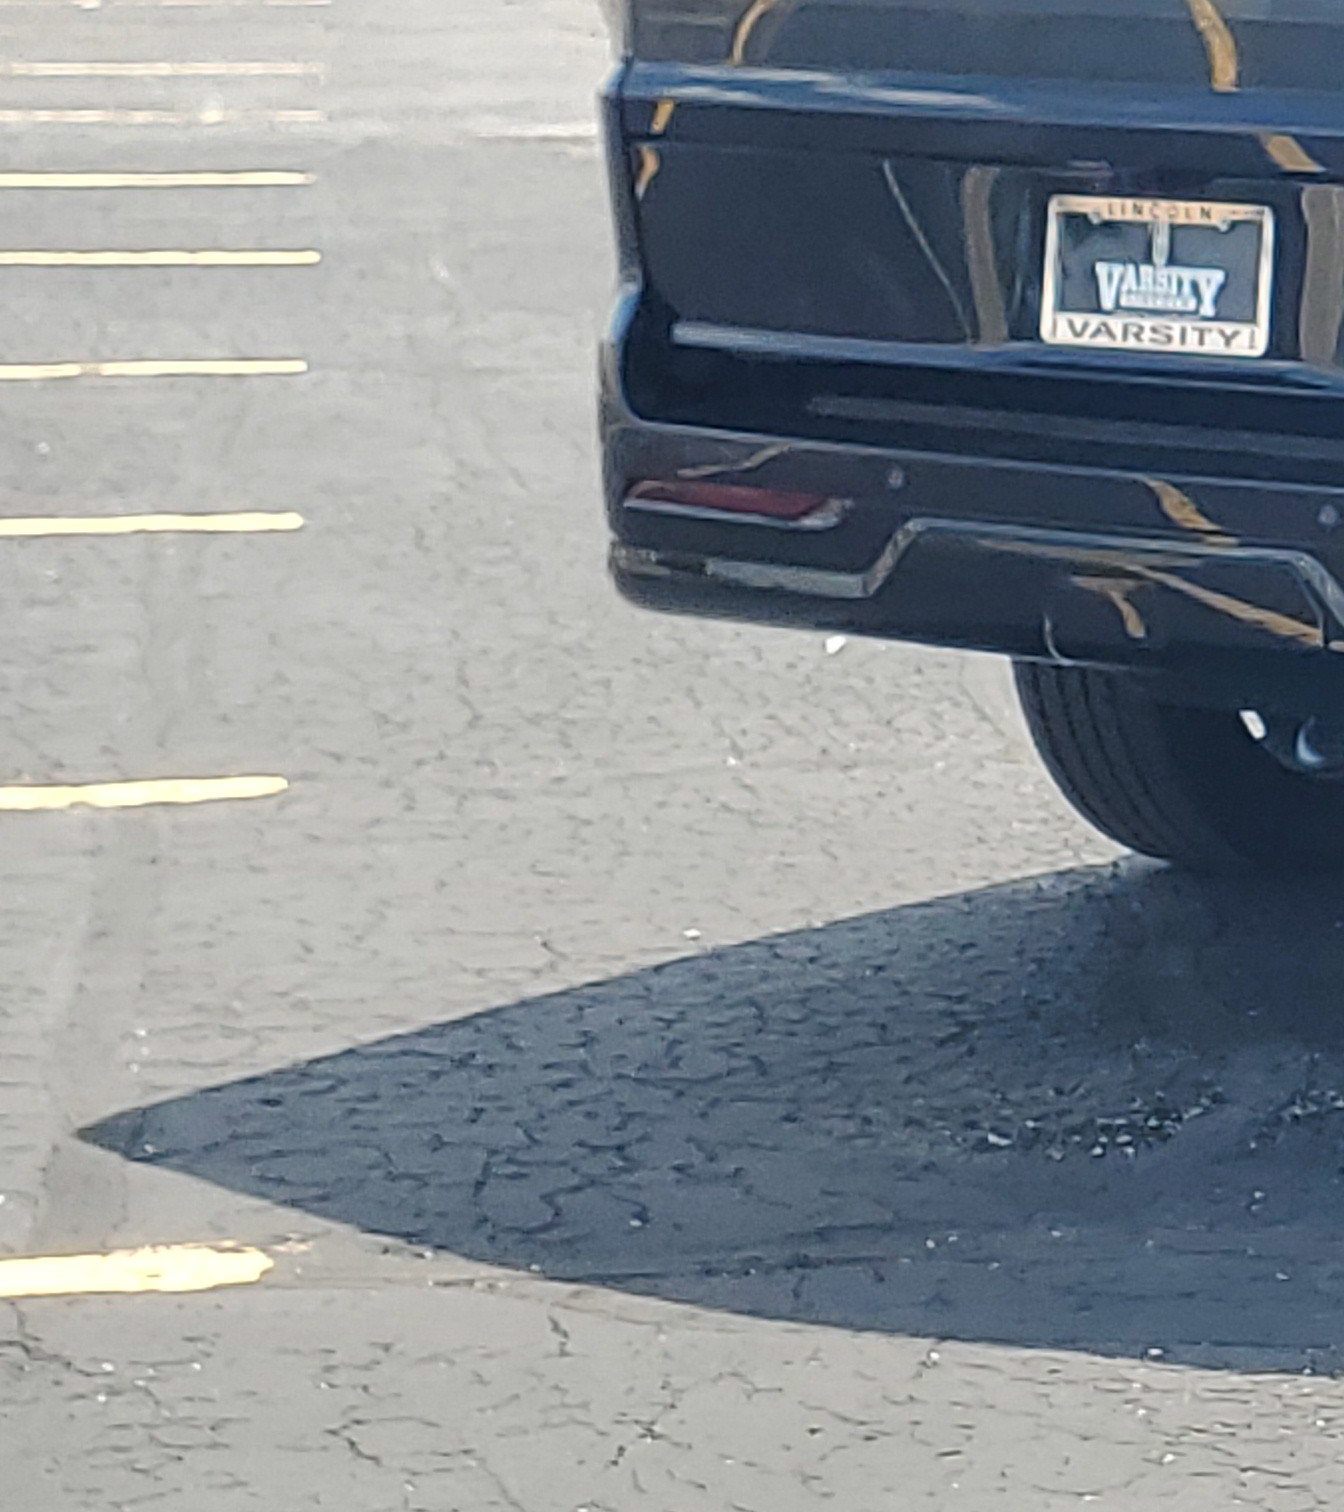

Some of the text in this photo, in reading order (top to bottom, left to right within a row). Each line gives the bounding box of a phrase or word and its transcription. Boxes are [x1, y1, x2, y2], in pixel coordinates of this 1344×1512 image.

[1107, 202, 1213, 220] LINCOLN
[1095, 261, 1225, 317] VARSITY
[1067, 318, 1241, 348] VARSITY
